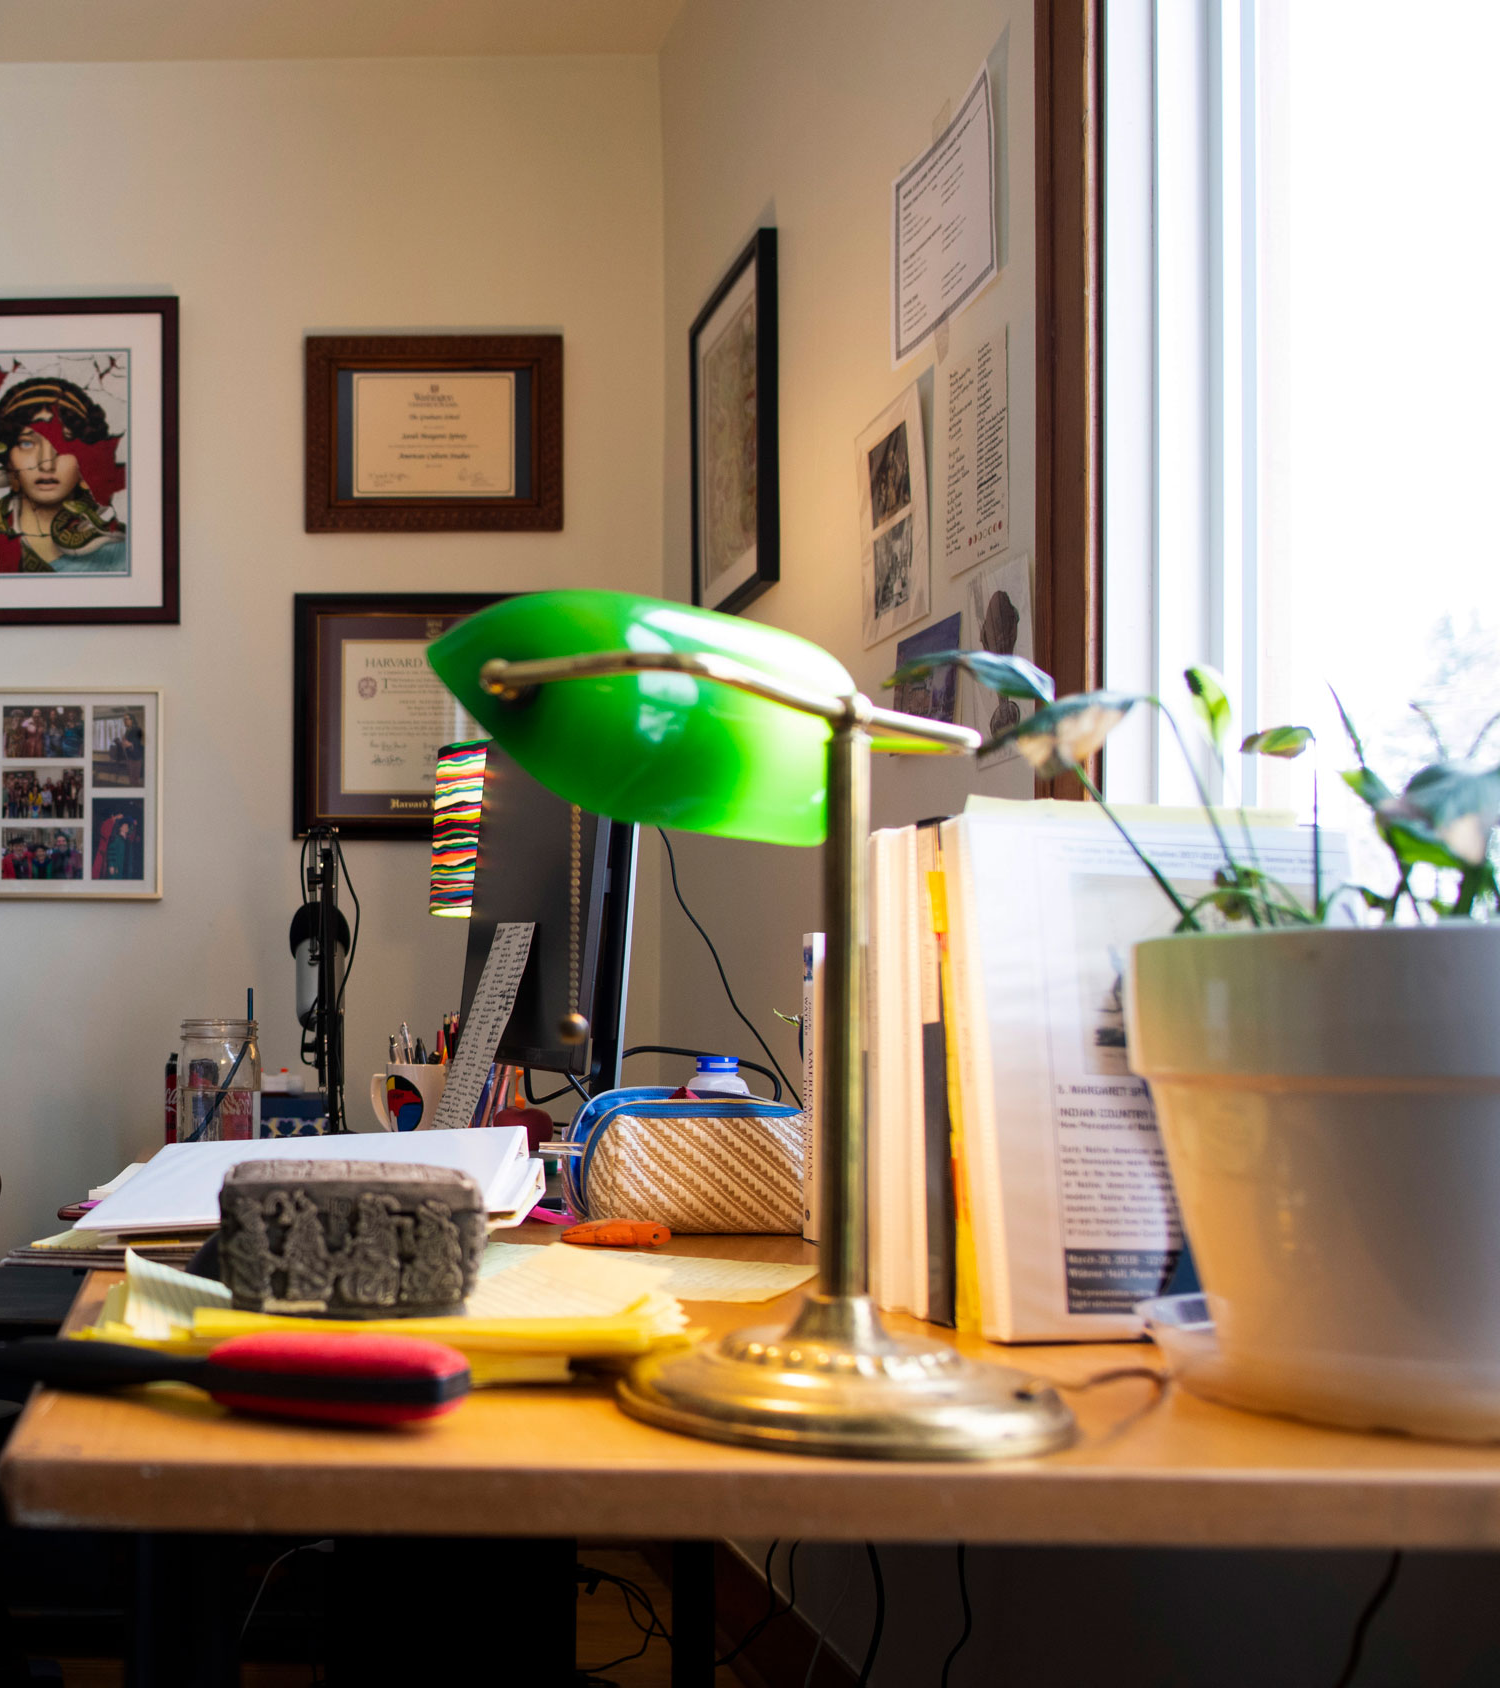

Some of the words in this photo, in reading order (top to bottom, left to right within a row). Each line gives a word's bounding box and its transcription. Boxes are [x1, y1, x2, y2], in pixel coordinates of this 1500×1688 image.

[365, 657, 423, 669] HARVARD
[390, 798, 428, 810] Harvard
[1069, 1084, 1127, 1096] MARGARET
[1099, 1108, 1149, 1119] COUNTRY
